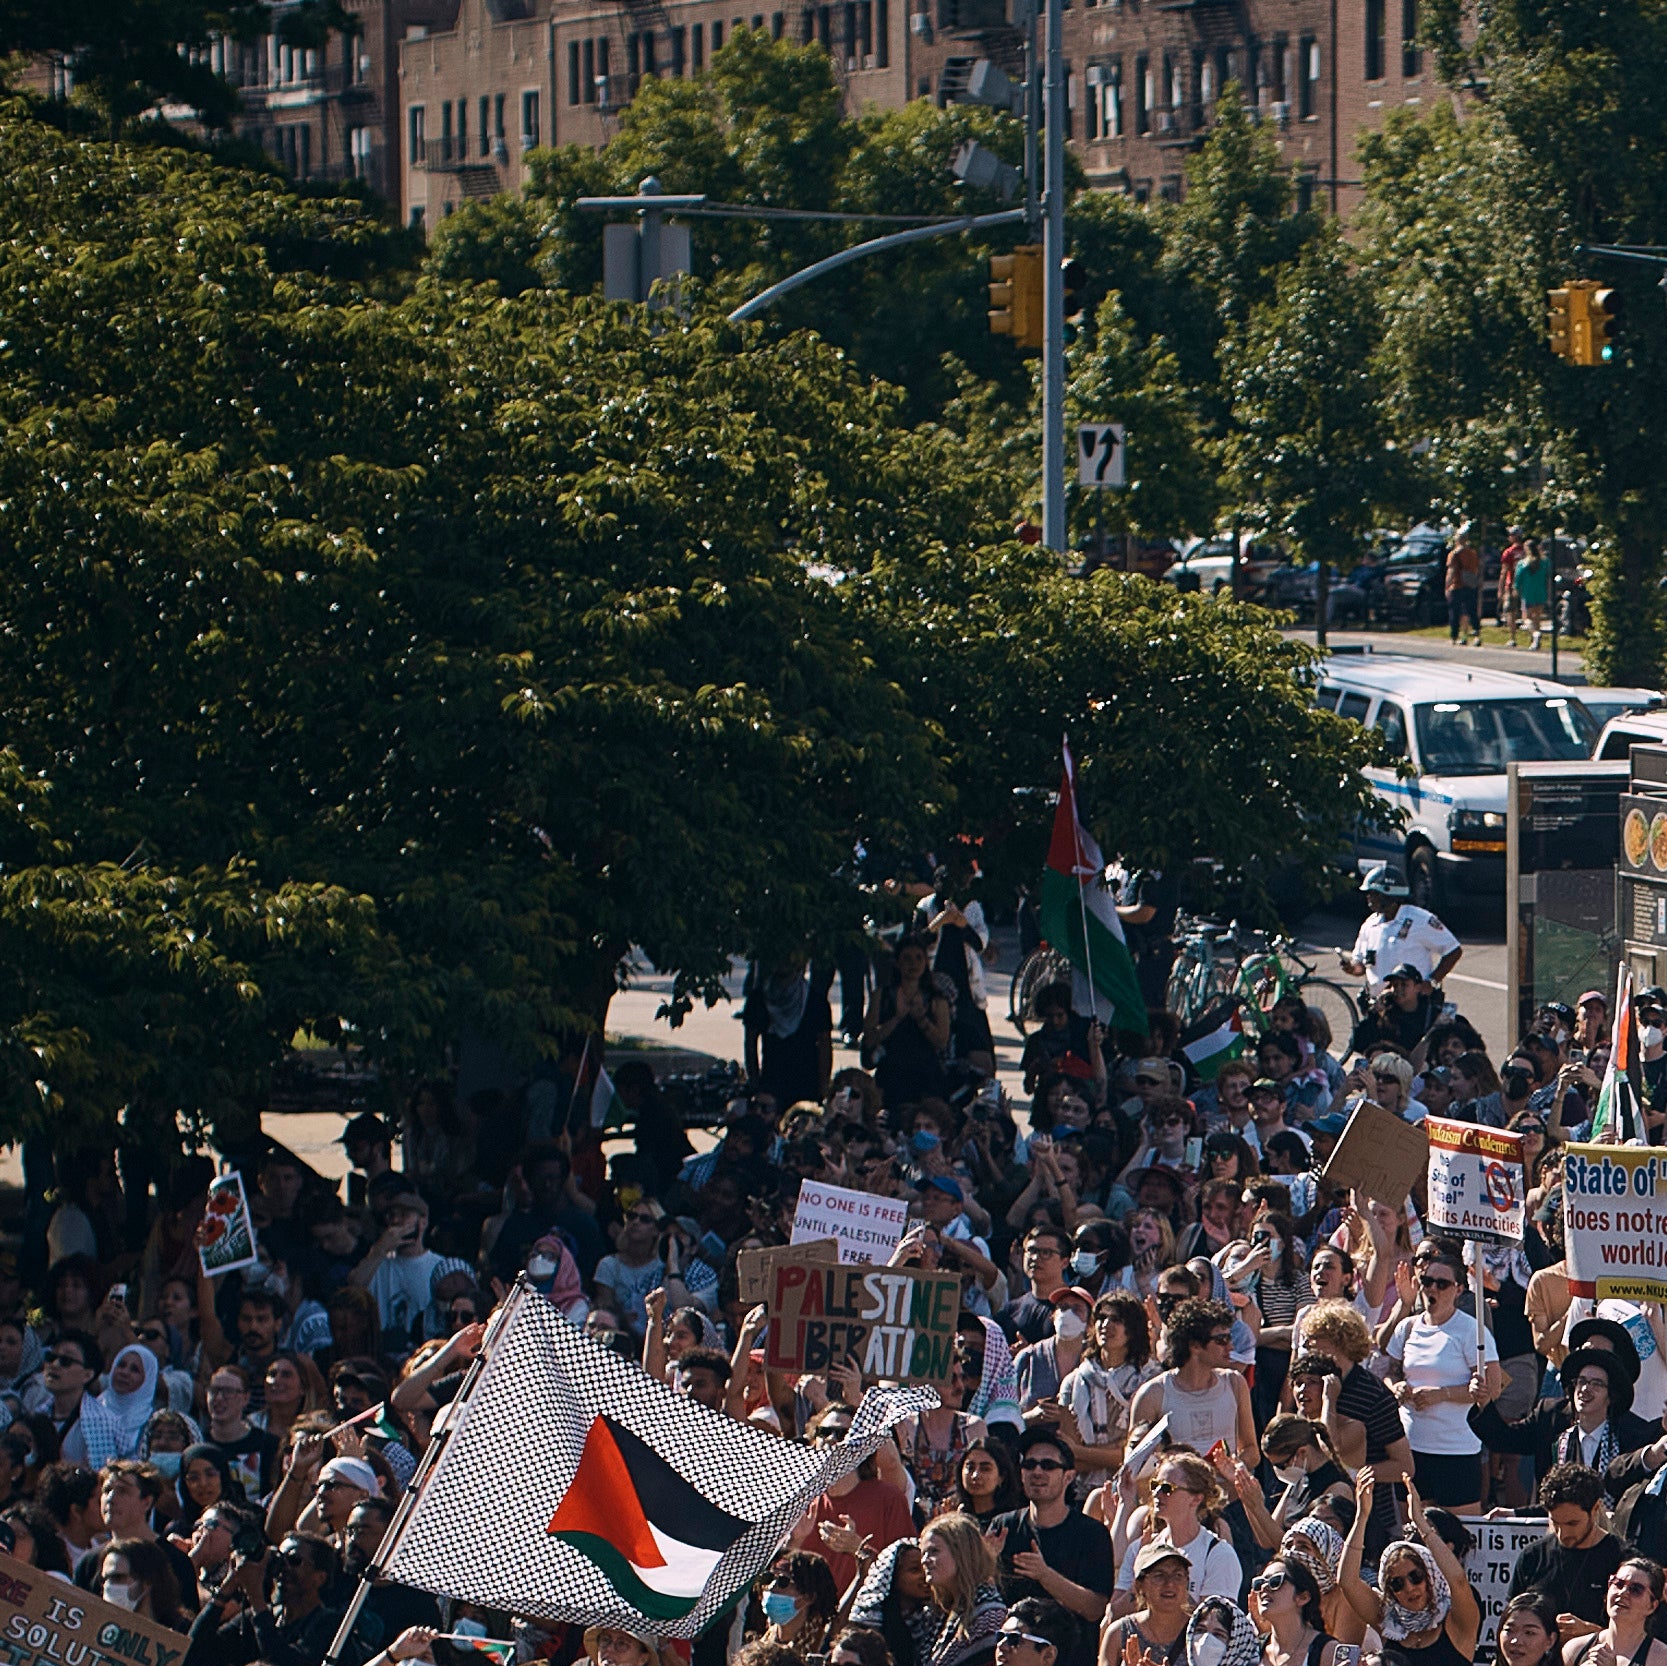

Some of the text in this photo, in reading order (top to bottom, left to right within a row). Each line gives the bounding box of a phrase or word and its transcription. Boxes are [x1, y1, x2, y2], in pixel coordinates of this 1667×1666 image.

[1428, 1123, 1461, 1145] Judaism
[1451, 1172, 1466, 1187] of
[1566, 1154, 1627, 1195] State
[1633, 1157, 1656, 1197] of
[801, 1191, 904, 1223] NO ONE IS FREE
[1567, 1204, 1610, 1231] does
[1616, 1208, 1652, 1233] not
[795, 1217, 901, 1247] UNTIL PALESTINE
[1442, 1208, 1520, 1235] its Atrocities
[842, 1249, 872, 1263] FREE
[1601, 1240, 1655, 1266] world
[776, 1266, 958, 1332] PALESTINE
[767, 1318, 953, 1380] LIBERATION
[1489, 1530, 1504, 1550] is
[1468, 1569, 1483, 1583] for
[46, 1597, 85, 1630] IS
